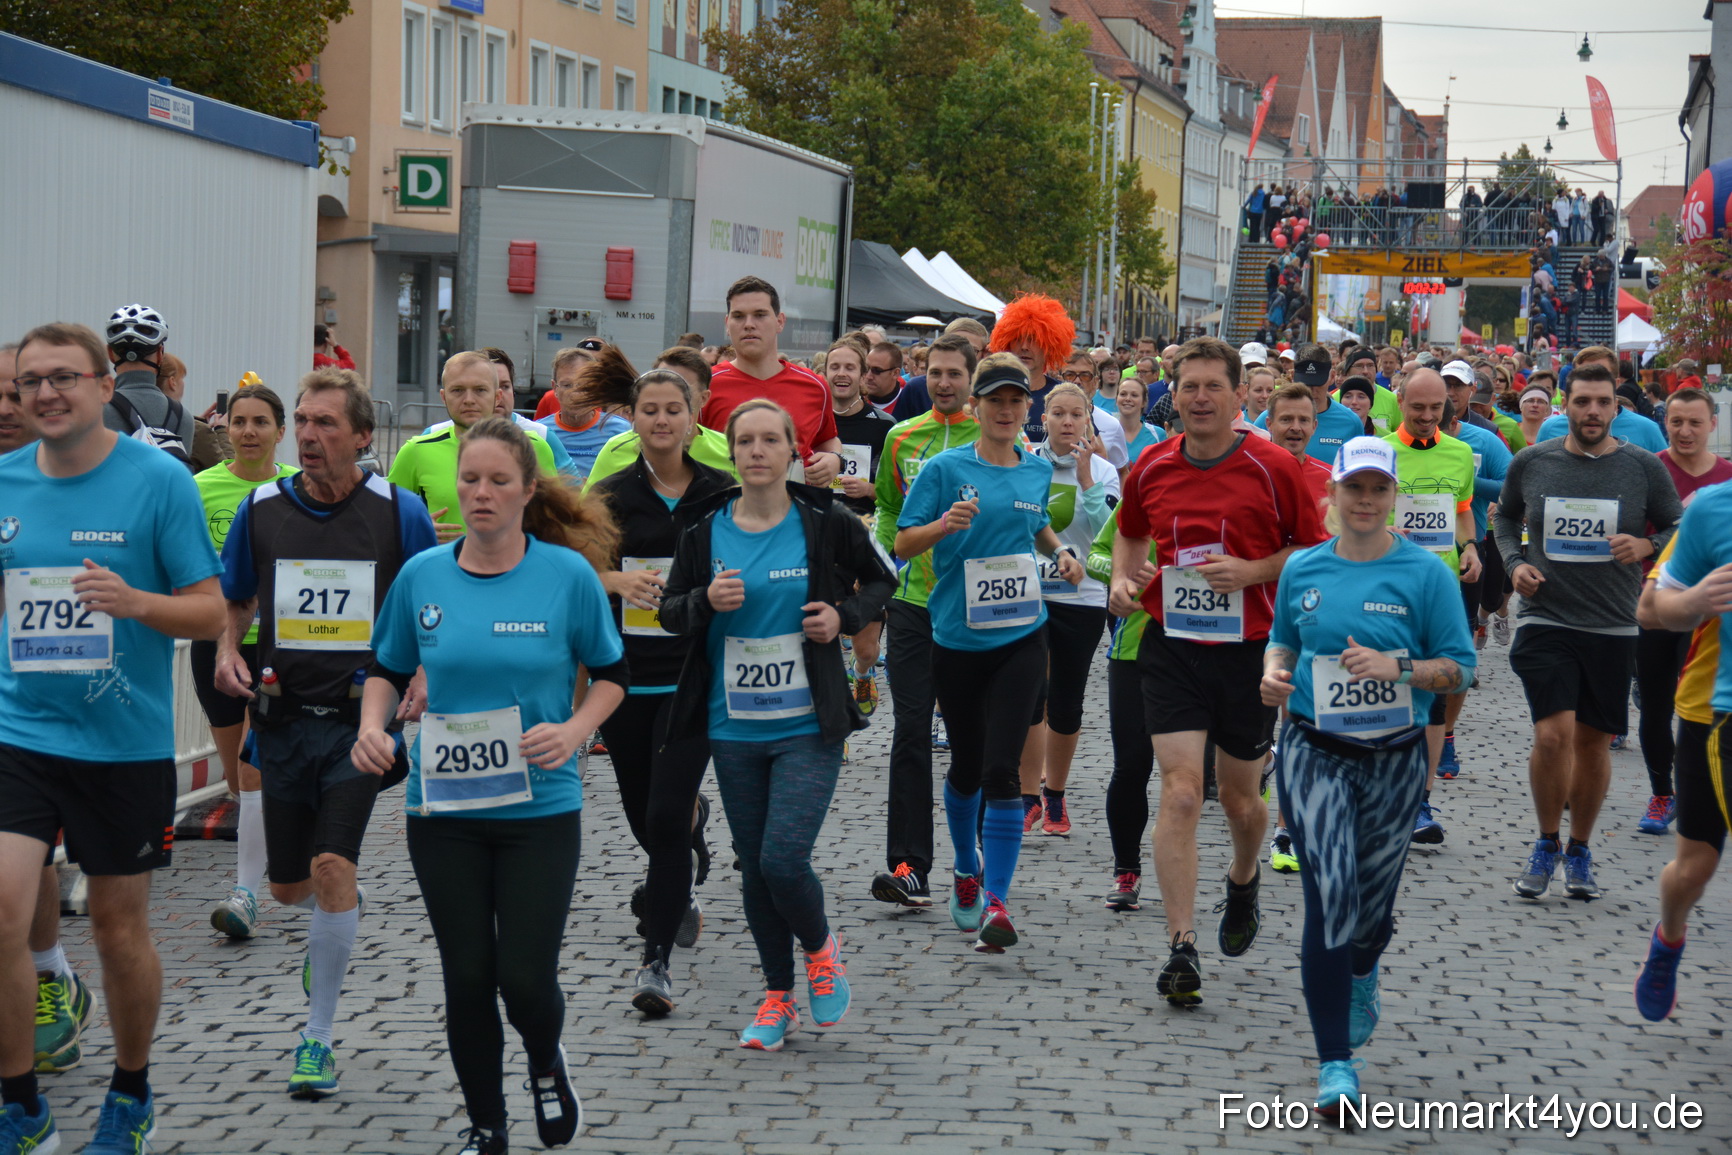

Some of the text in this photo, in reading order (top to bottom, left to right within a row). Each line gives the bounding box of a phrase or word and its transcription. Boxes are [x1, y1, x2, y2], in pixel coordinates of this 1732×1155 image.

[407, 163, 442, 199] D
[710, 218, 784, 259] OFFICE INDUSTRY LOUNGE
[796, 217, 837, 288] BOCK
[1402, 256, 1449, 273] ZIEL
[638, 312, 655, 320] 1106
[1319, 437, 1343, 445] BOCK
[1351, 448, 1387, 458] ERDINGER
[1403, 512, 1447, 529] 2528
[1554, 517, 1605, 537] 2524
[71, 530, 126, 543] BOCK
[1413, 534, 1437, 542] Thomas
[1561, 543, 1597, 551] Alexander
[313, 569, 346, 577] BOCK
[40, 577, 73, 587] BOC
[1041, 583, 1061, 591] orinna
[977, 576, 1027, 602] 2587
[298, 588, 351, 615] 217
[1175, 587, 1230, 612] 2534
[19, 599, 94, 631] 2792
[992, 606, 1018, 617] Verena
[1363, 602, 1409, 615] BOCK
[308, 624, 340, 634] Lothar
[493, 621, 547, 633] BOCK
[1186, 618, 1218, 628] Gerhard
[12, 639, 86, 658] Thomas
[736, 660, 795, 688] 2207
[753, 695, 783, 706] Carina
[1328, 680, 1396, 708] 2588
[1342, 713, 1387, 726] Michaela
[435, 739, 509, 773] 2930
